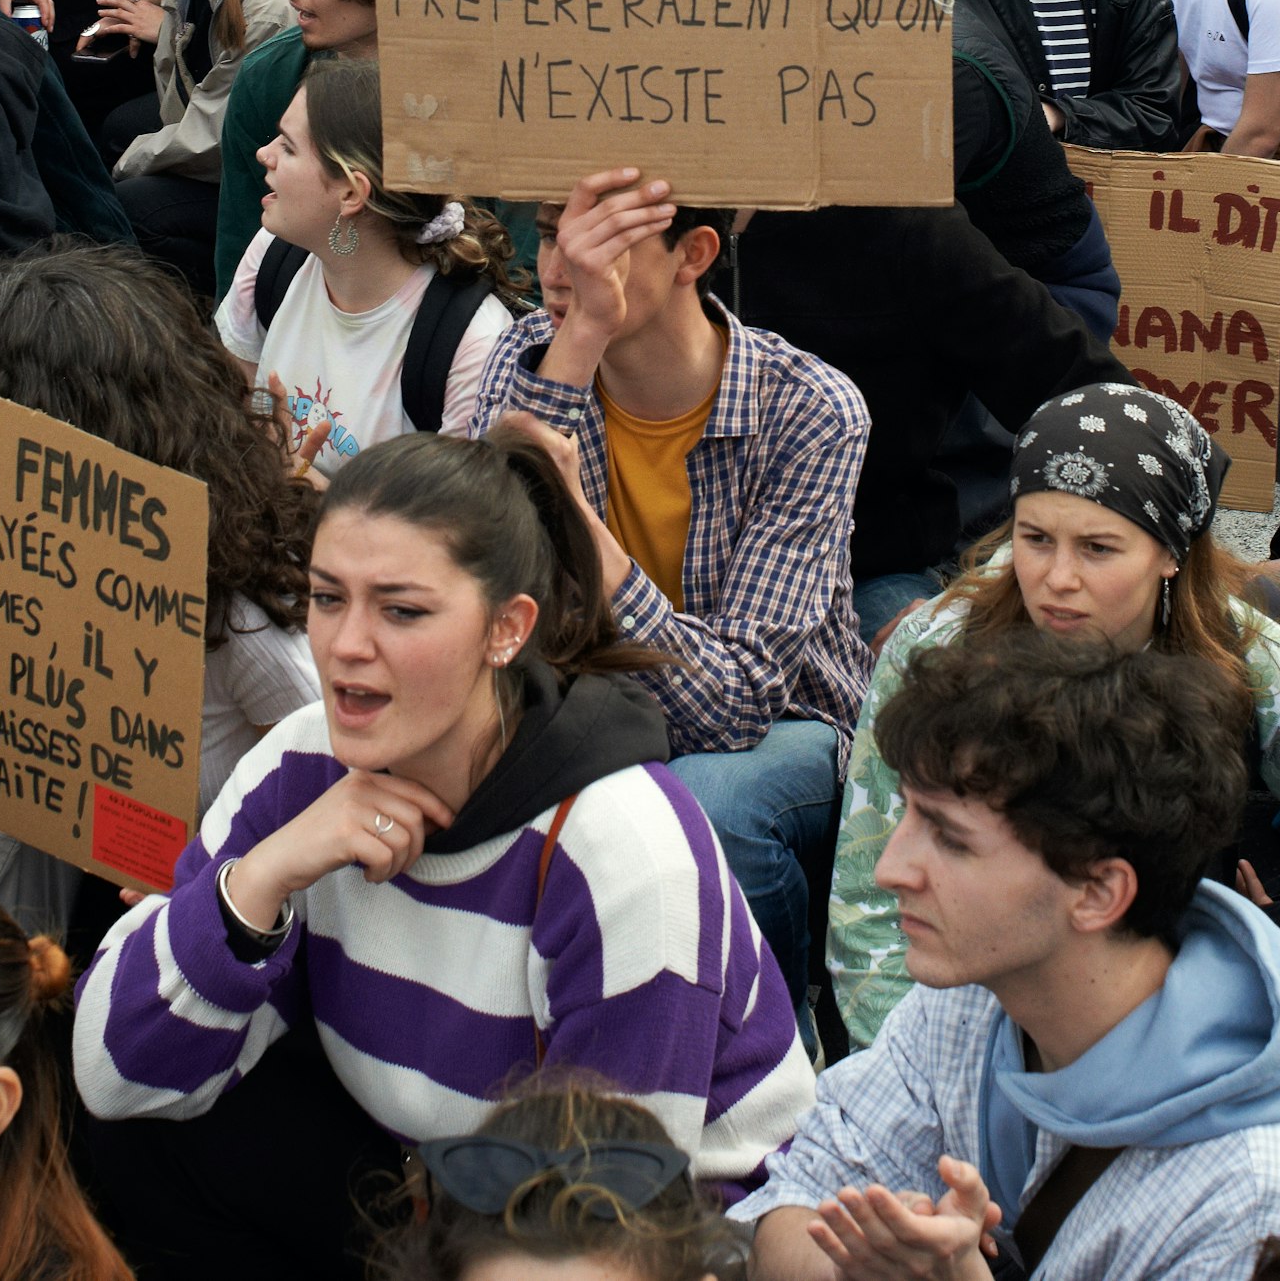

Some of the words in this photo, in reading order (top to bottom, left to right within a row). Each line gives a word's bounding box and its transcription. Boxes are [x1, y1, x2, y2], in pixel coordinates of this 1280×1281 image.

[498, 51, 726, 126] N'EXISTE
[777, 64, 878, 128] PAS
[16, 436, 172, 562] FEMMES
[96, 567, 206, 638] COMME
[134, 647, 159, 697] Y
[91, 743, 134, 791] DE
[110, 706, 185, 770] DANS
